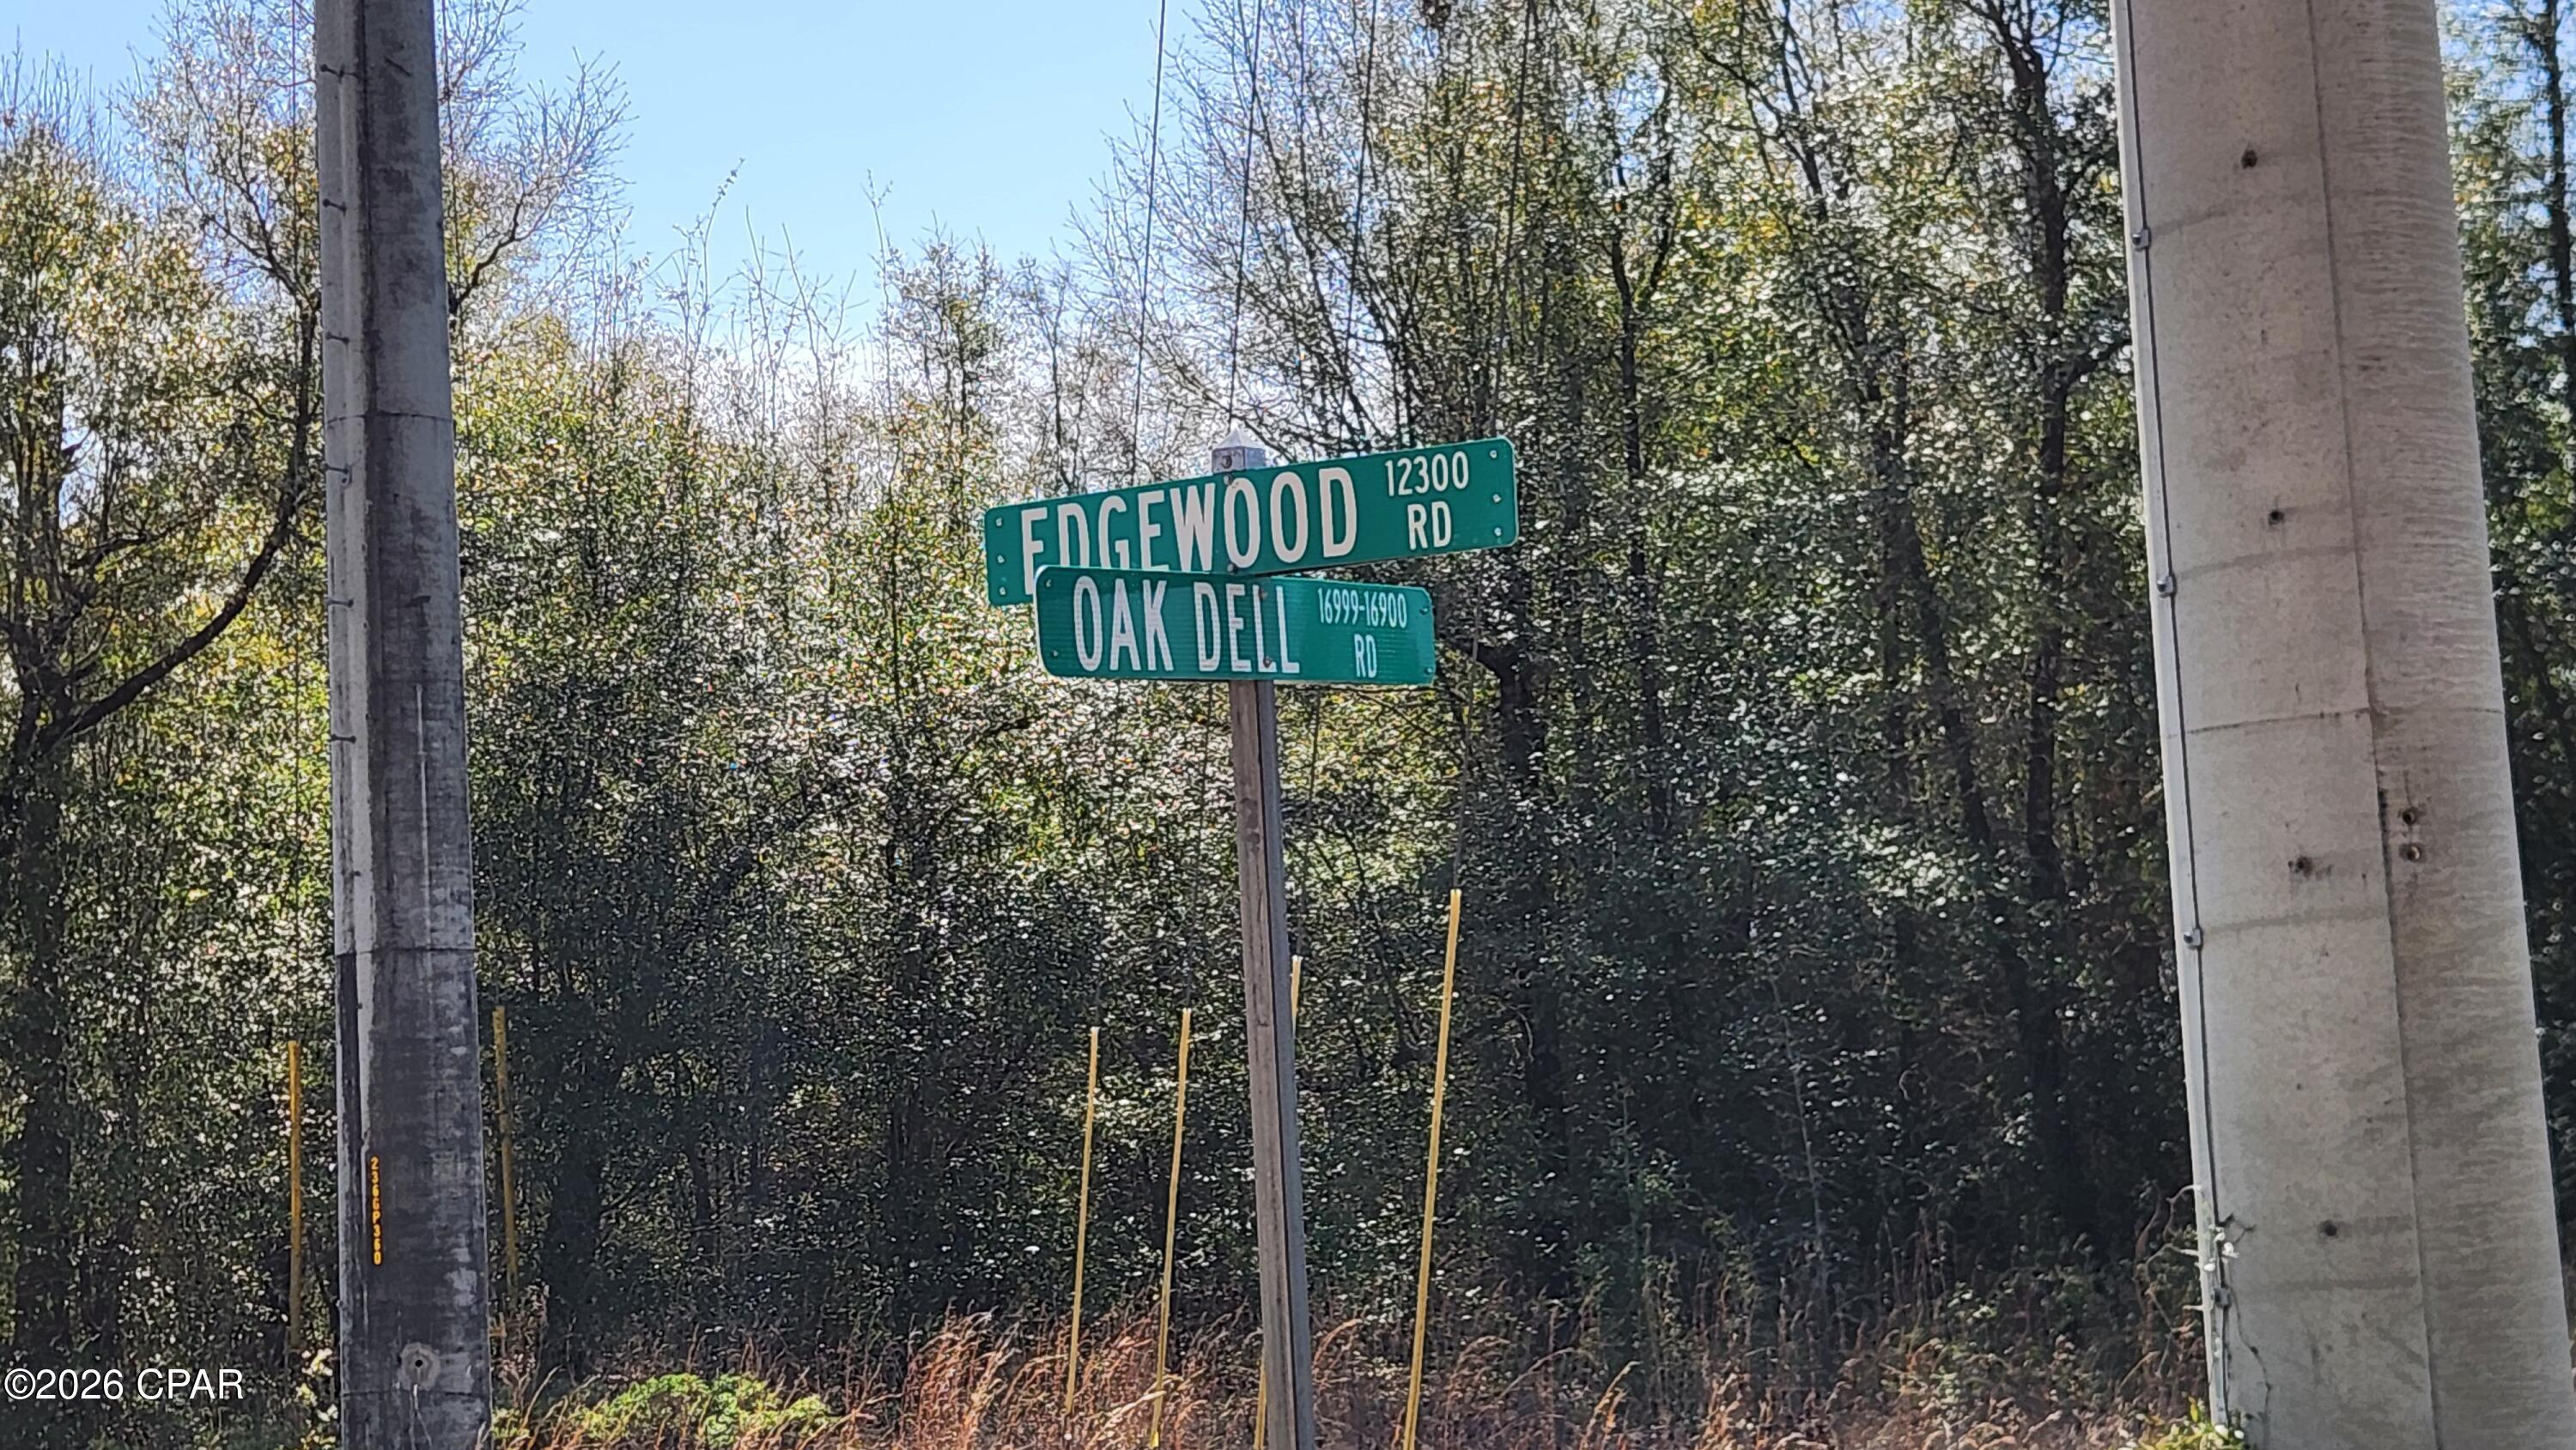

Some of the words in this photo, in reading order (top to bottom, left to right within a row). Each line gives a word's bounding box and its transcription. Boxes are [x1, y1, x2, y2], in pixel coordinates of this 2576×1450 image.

[1385, 451, 1469, 496] 12300
[1021, 466, 1358, 595] EDGEWOOD
[1407, 501, 1452, 550] RD
[1073, 575, 1175, 672] OAK
[1194, 581, 1301, 675] DELL
[1317, 587, 1407, 628] 16999-16900
[1353, 633, 1377, 678] RD
